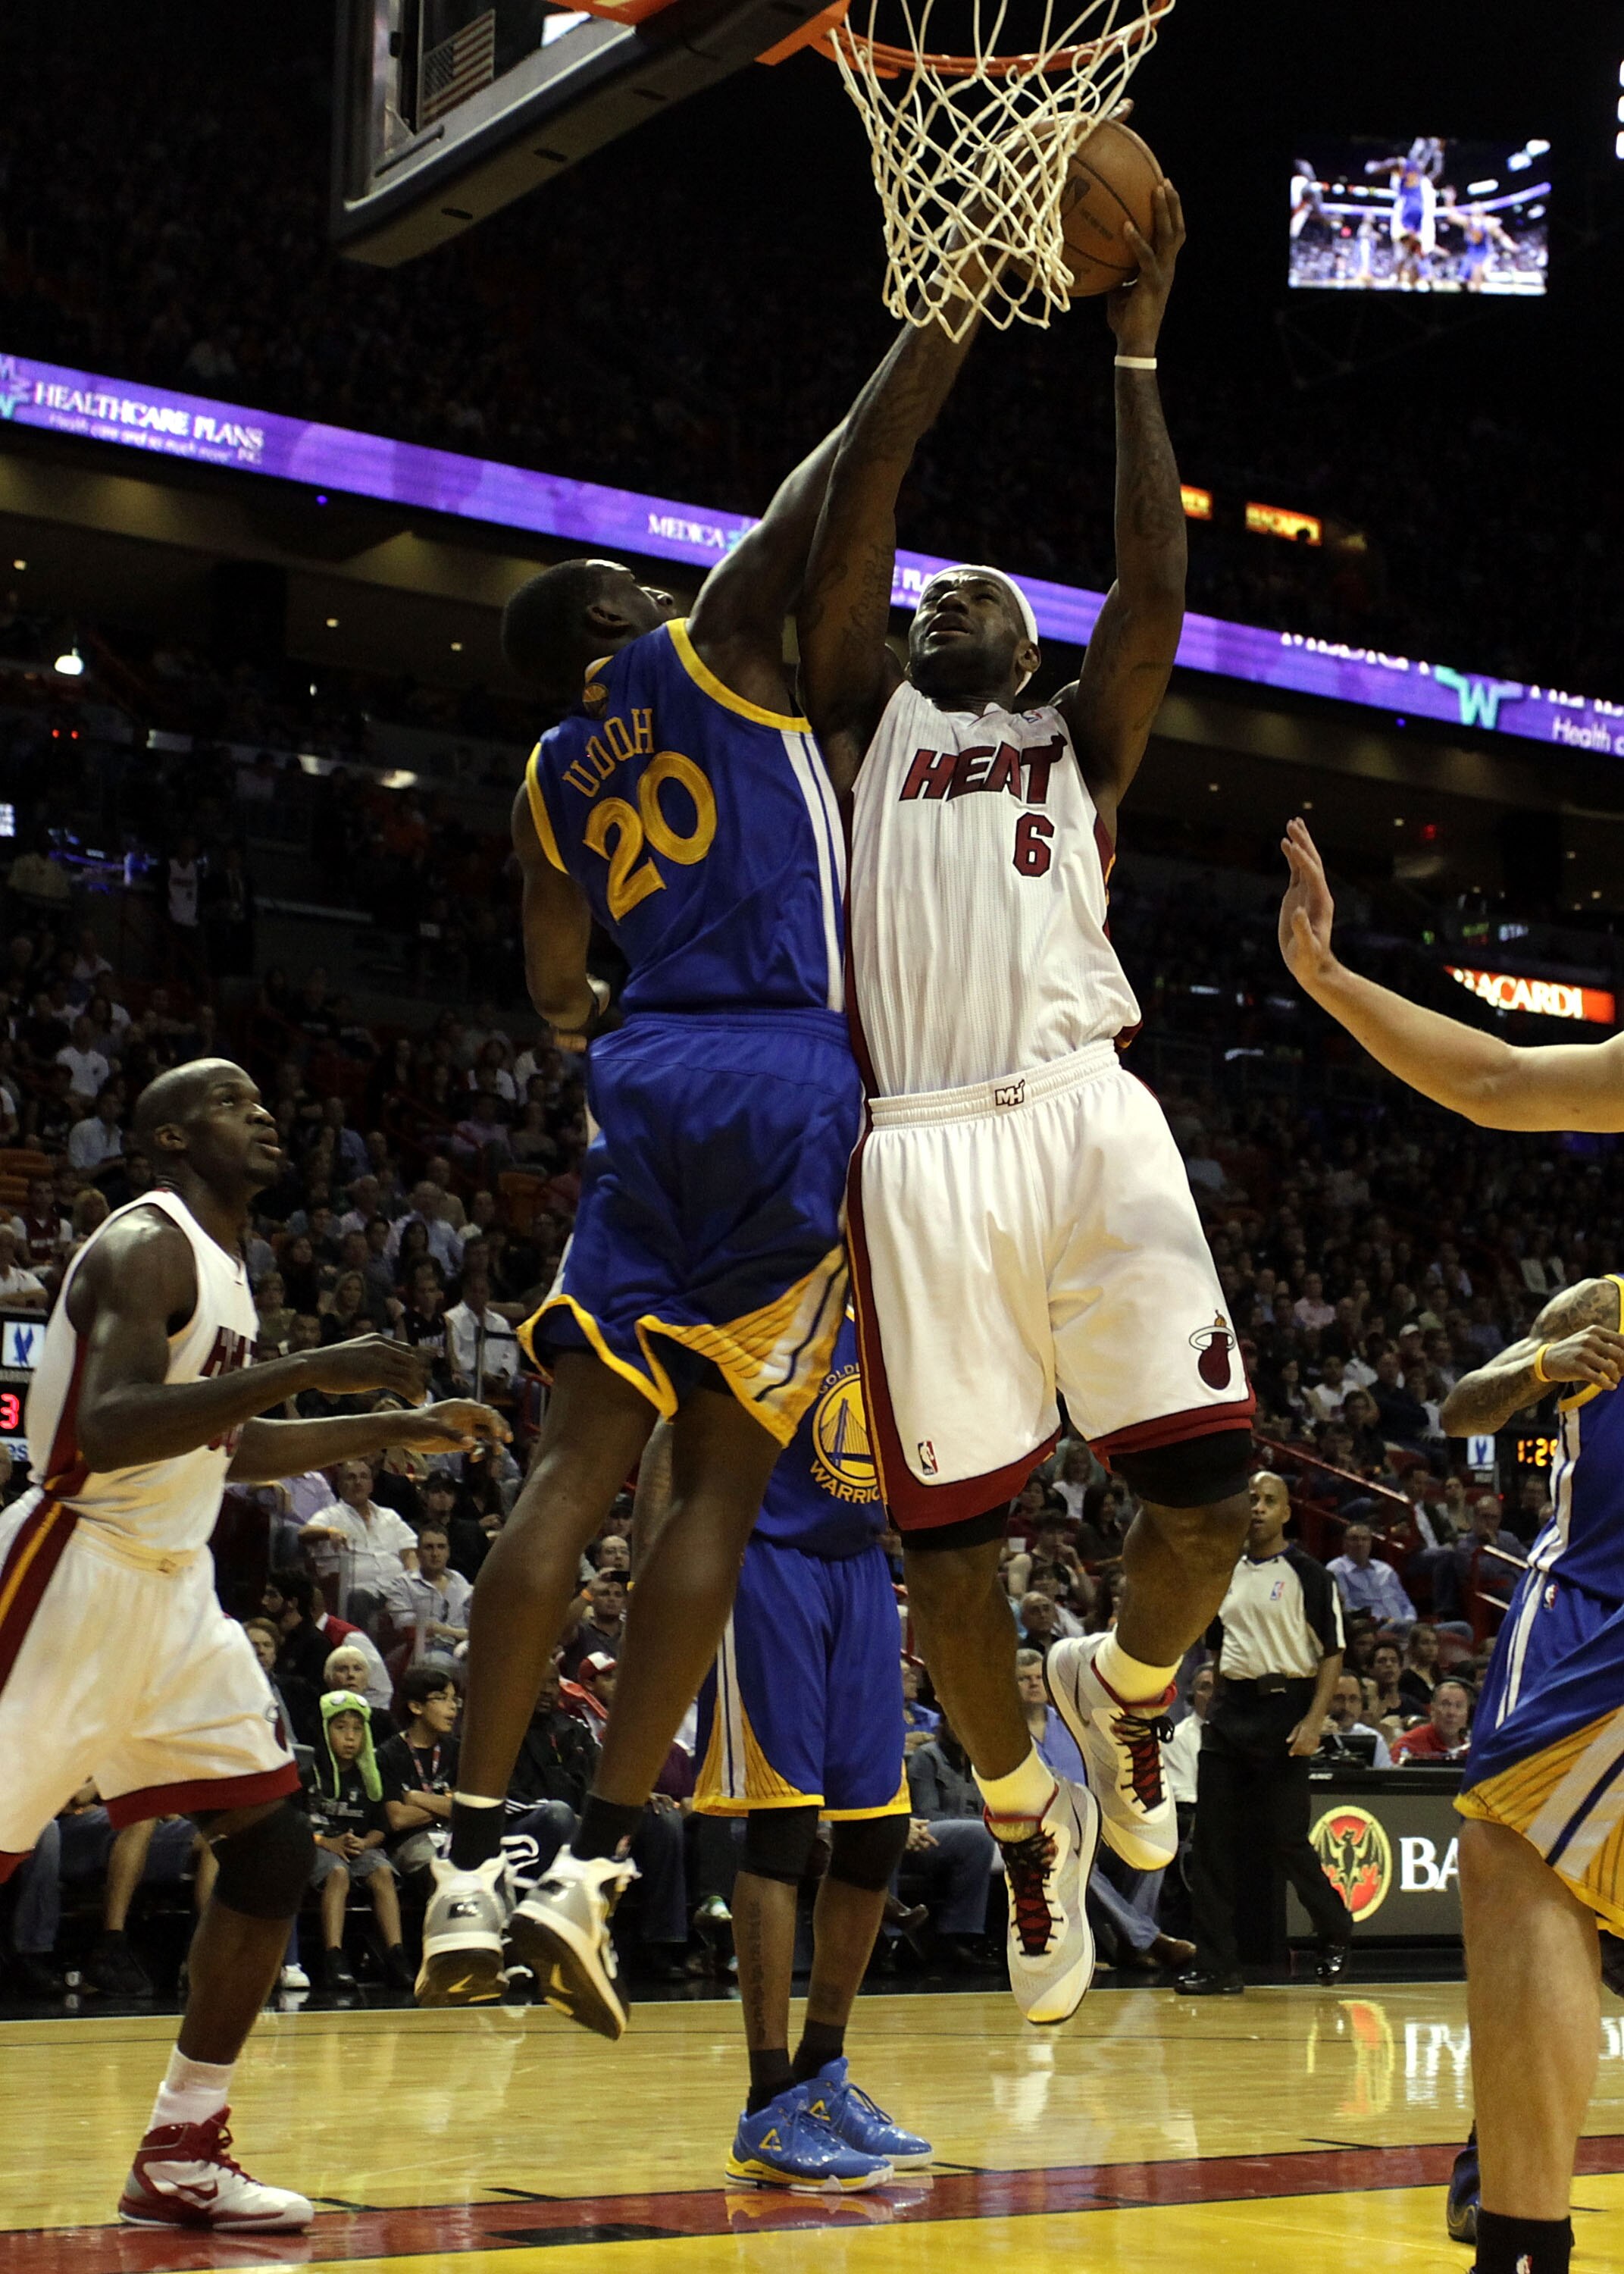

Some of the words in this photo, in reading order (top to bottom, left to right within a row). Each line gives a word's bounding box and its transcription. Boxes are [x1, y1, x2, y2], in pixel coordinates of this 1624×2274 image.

[34, 381, 189, 437] HEALTHCARE
[194, 415, 264, 451] PLANS
[648, 512, 725, 550] MEDICA
[562, 708, 655, 798] UDOH
[899, 731, 1068, 804] HEAT
[1552, 716, 1612, 753] Health
[582, 750, 717, 925] 20
[1012, 811, 1056, 878] 6
